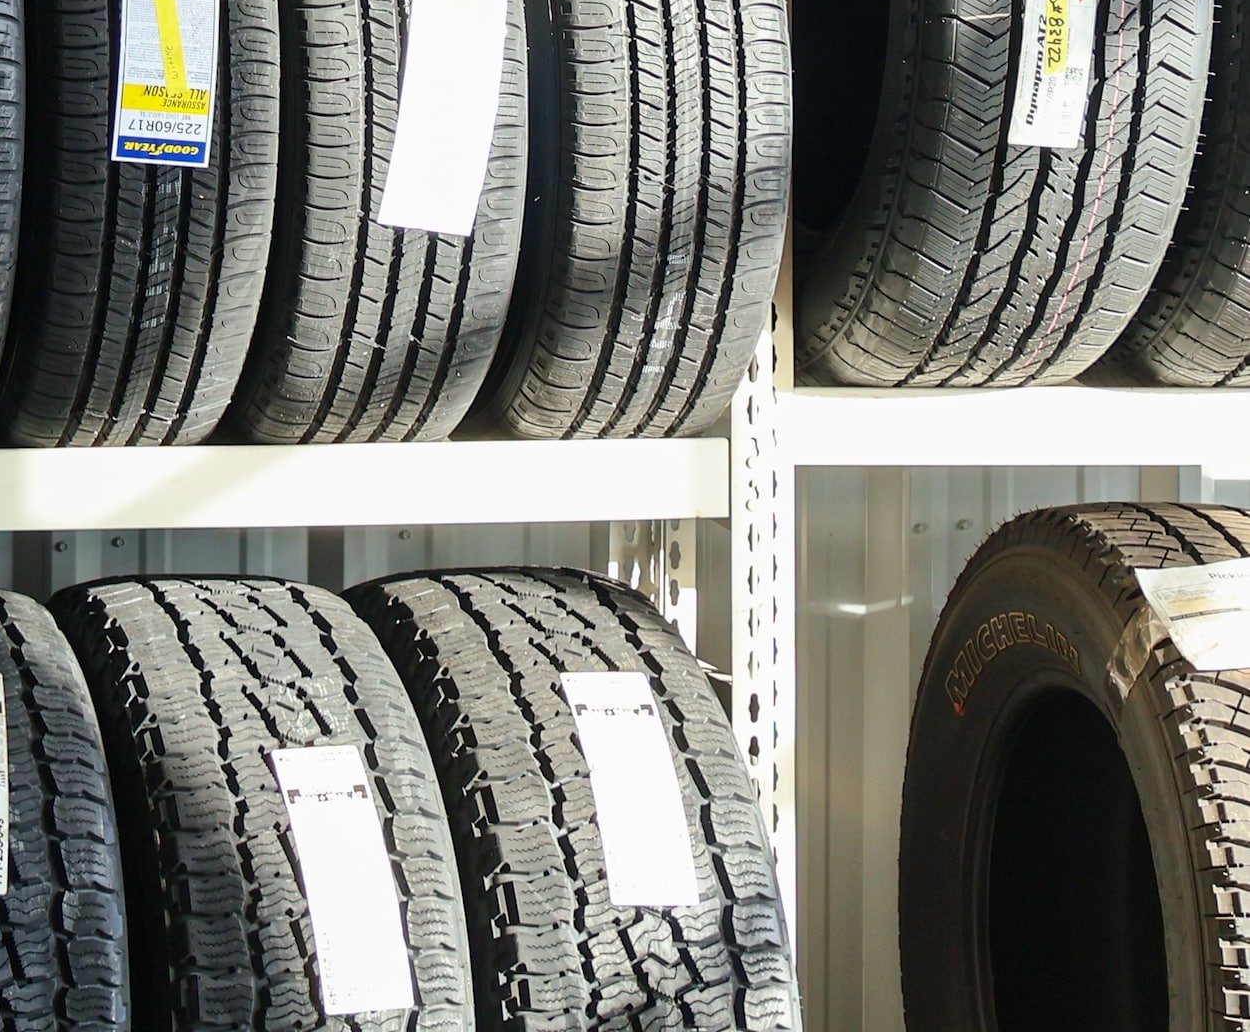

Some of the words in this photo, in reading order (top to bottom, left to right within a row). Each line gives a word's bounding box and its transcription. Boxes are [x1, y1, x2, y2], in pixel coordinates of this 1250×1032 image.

[1047, 16, 1064, 68] 83422
[1025, 51, 1044, 126] Dynapro
[1038, 13, 1048, 48] AT2
[161, 98, 206, 110] ASSURANCE
[129, 119, 202, 135] 225/60R17
[124, 141, 199, 156] GOODYEAR
[945, 611, 1084, 705] MICHELIN
